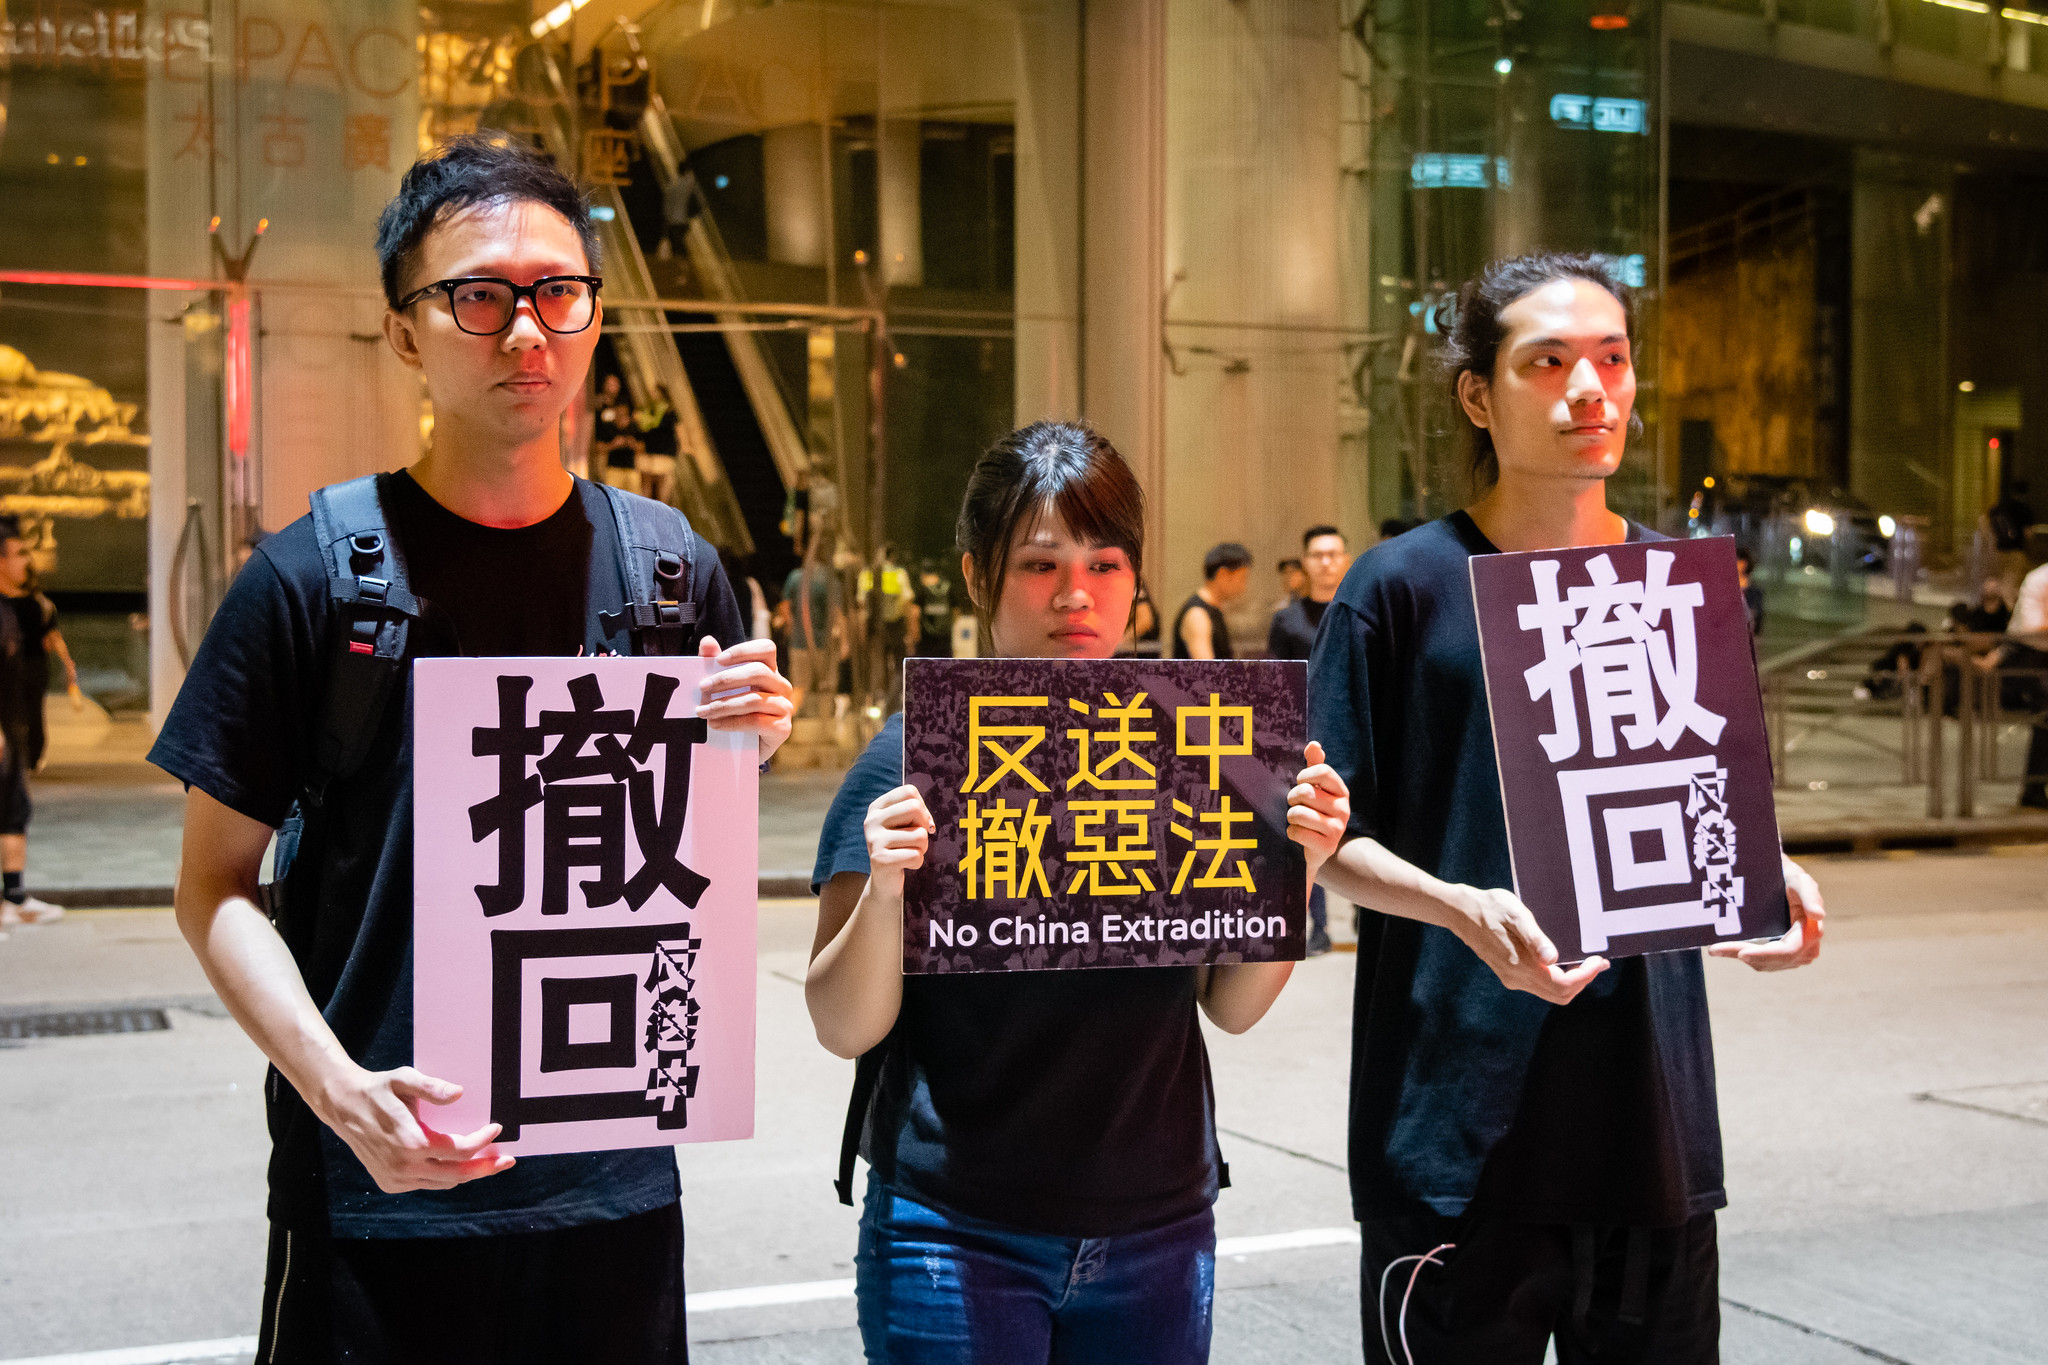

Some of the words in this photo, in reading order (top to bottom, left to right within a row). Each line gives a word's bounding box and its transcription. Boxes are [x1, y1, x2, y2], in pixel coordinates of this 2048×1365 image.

[958, 692, 1253, 794] 反送中
[1517, 549, 1743, 954] 撤回
[958, 795, 1258, 900] 撤惡法
[468, 672, 711, 1142] 撤回
[929, 919, 978, 948] No
[988, 915, 1090, 946] China
[1102, 909, 1287, 943] Extradition
